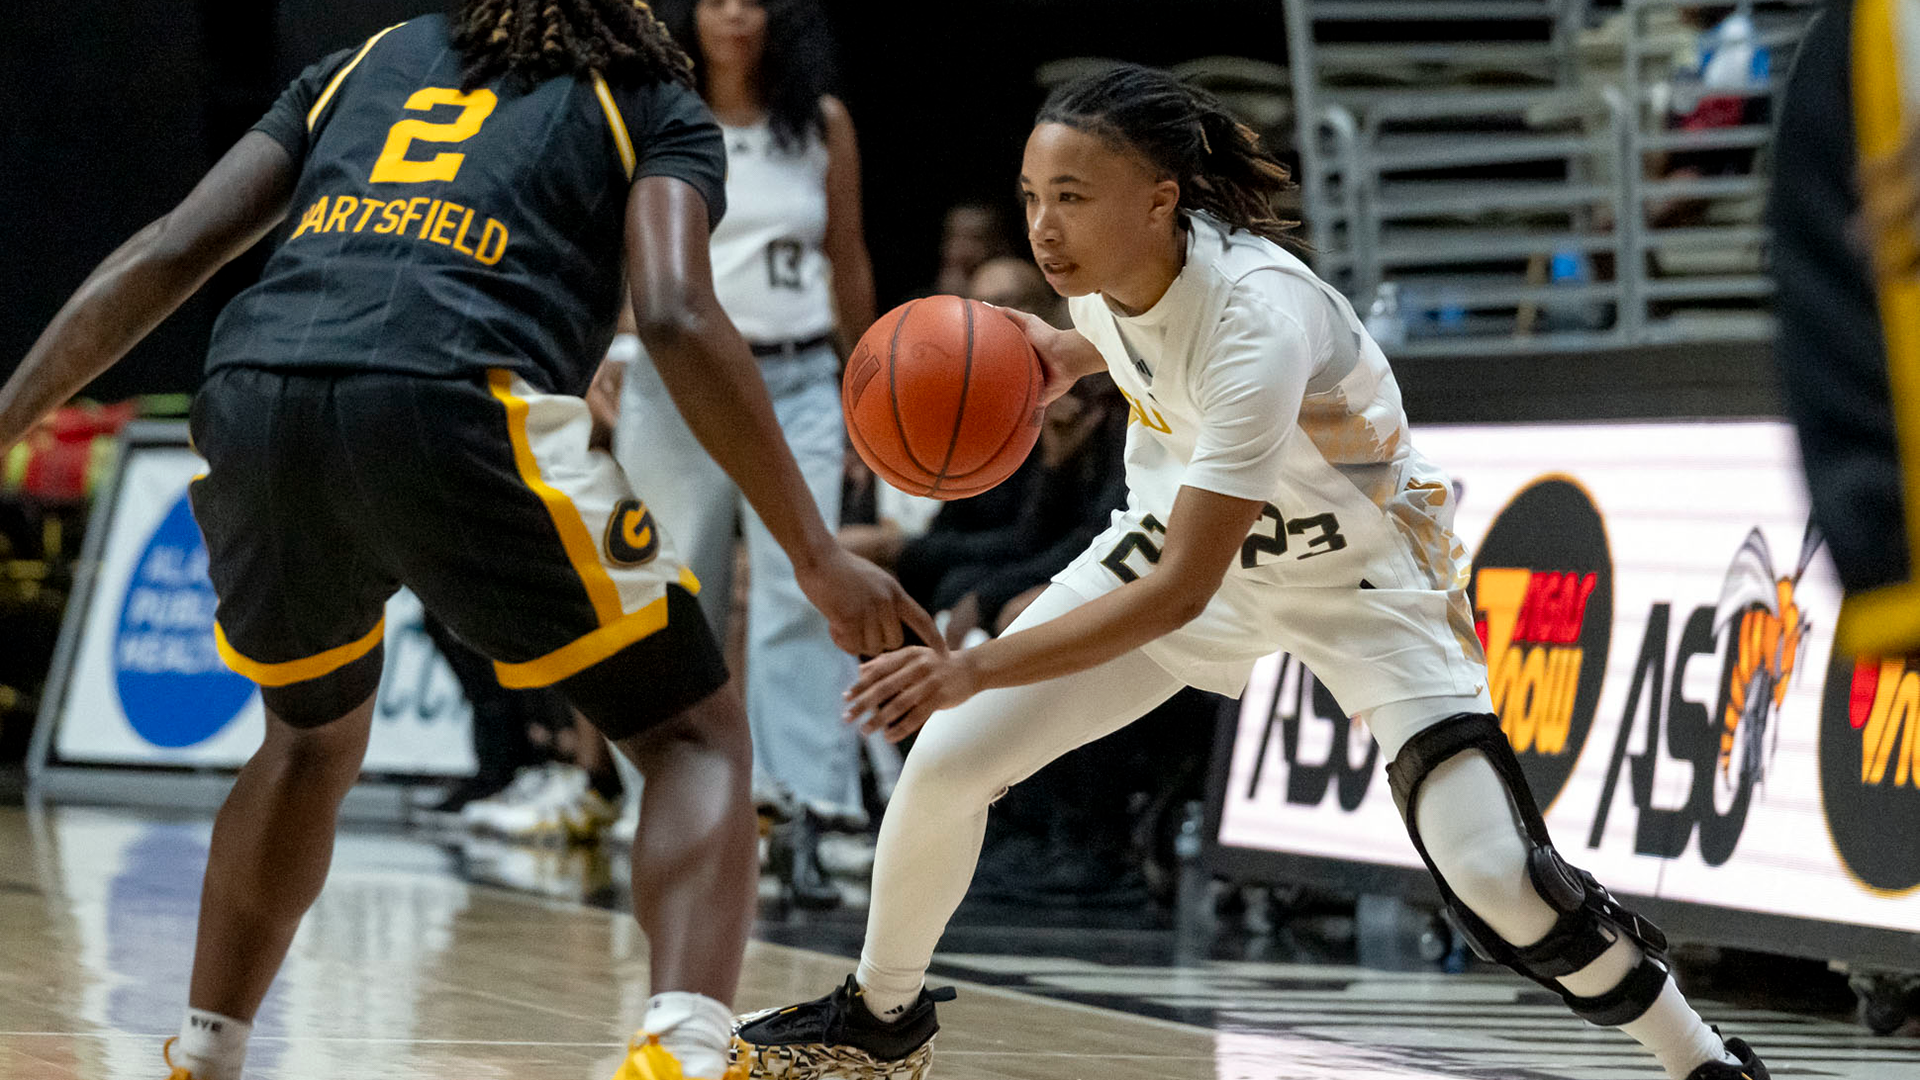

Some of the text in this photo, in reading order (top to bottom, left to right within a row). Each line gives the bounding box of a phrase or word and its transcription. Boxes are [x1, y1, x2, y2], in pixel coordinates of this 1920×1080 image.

[369, 86, 498, 183] 2
[291, 195, 509, 265] ARTSFIELD
[1240, 501, 1348, 569] 23
